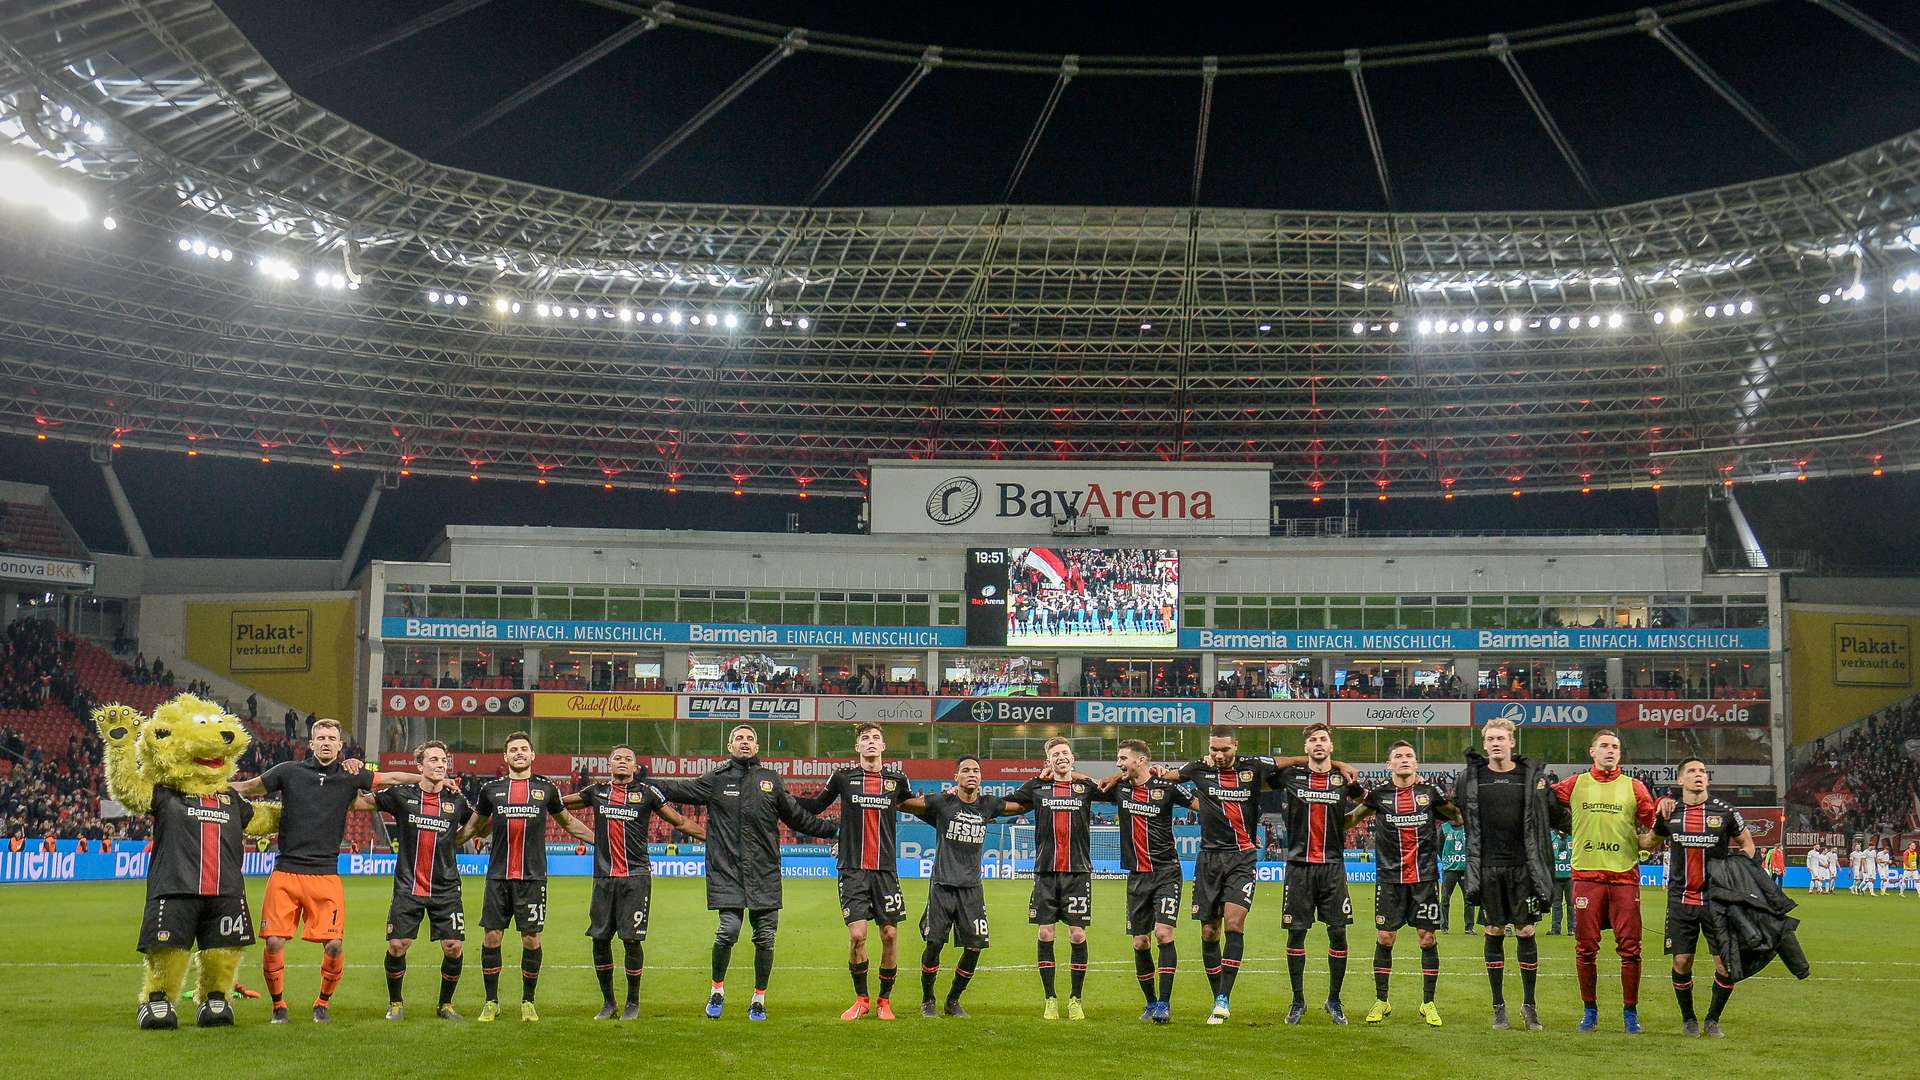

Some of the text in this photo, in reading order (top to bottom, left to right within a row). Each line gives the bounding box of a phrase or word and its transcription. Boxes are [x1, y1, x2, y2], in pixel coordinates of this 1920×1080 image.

[995, 483, 1215, 522] BayArena
[975, 552, 1004, 564] 19:51
[971, 598, 1005, 606] BayArena
[236, 624, 303, 642] Plakat-
[406, 619, 666, 642] Barmenia EINFACH. MENSCHLICH.
[690, 624, 943, 646] Barmenia EINFACH. MENSCHLICH.
[1199, 631, 1456, 649] Barmenia EINFACH. MENSCHLICH.
[1478, 630, 1743, 649] Barmenia EINFACH. MENSCHLICH.
[1840, 636, 1905, 655] Plakat-
[236, 643, 303, 656] verkauft.de
[1841, 659, 1905, 670] verkauft.de
[567, 695, 641, 717] Rudolf Weber
[877, 708, 923, 721] quinta
[998, 702, 1054, 723] Bayer
[1087, 702, 1196, 724] Barmenia
[1366, 705, 1420, 722] Lagardère
[1531, 706, 1588, 723] JAKO
[1638, 704, 1749, 725] bayer04.de
[1283, 711, 1315, 719] GROUP
[571, 757, 608, 774] EXPR
[651, 757, 676, 774] Wo
[852, 795, 892, 805] Barmenia
[1208, 787, 1250, 797] Barmenia
[1297, 789, 1340, 800] Barmenia
[497, 805, 540, 815] Barmenia
[1042, 798, 1082, 807] Barmenia
[1122, 800, 1161, 813] Barmenia
[1582, 802, 1622, 811] Barmenia
[188, 807, 230, 822] Barmenia
[599, 805, 638, 818] Barmenia
[1385, 812, 1428, 823] Barmenia
[408, 814, 451, 829] Barmenia
[947, 821, 986, 837] JESUS
[946, 832, 957, 841] IST
[958, 834, 971, 843] DER
[1672, 833, 1720, 843] Barmenia
[1597, 842, 1619, 852] JAKO
[350, 854, 398, 875] Barm
[781, 866, 831, 877] ENSCHLICH.
[1347, 872, 1377, 882] MENSC
[1242, 881, 1253, 898] 4
[884, 893, 903, 913] 29
[1067, 896, 1087, 914] 23
[1160, 897, 1176, 915] 13
[1342, 897, 1351, 914] 6
[332, 909, 338, 926] 1
[527, 903, 544, 922] 31
[633, 911, 643, 928] 9
[1416, 903, 1438, 921] 20
[220, 914, 244, 936] 04
[450, 912, 464, 930] 15
[973, 918, 988, 935] 18
